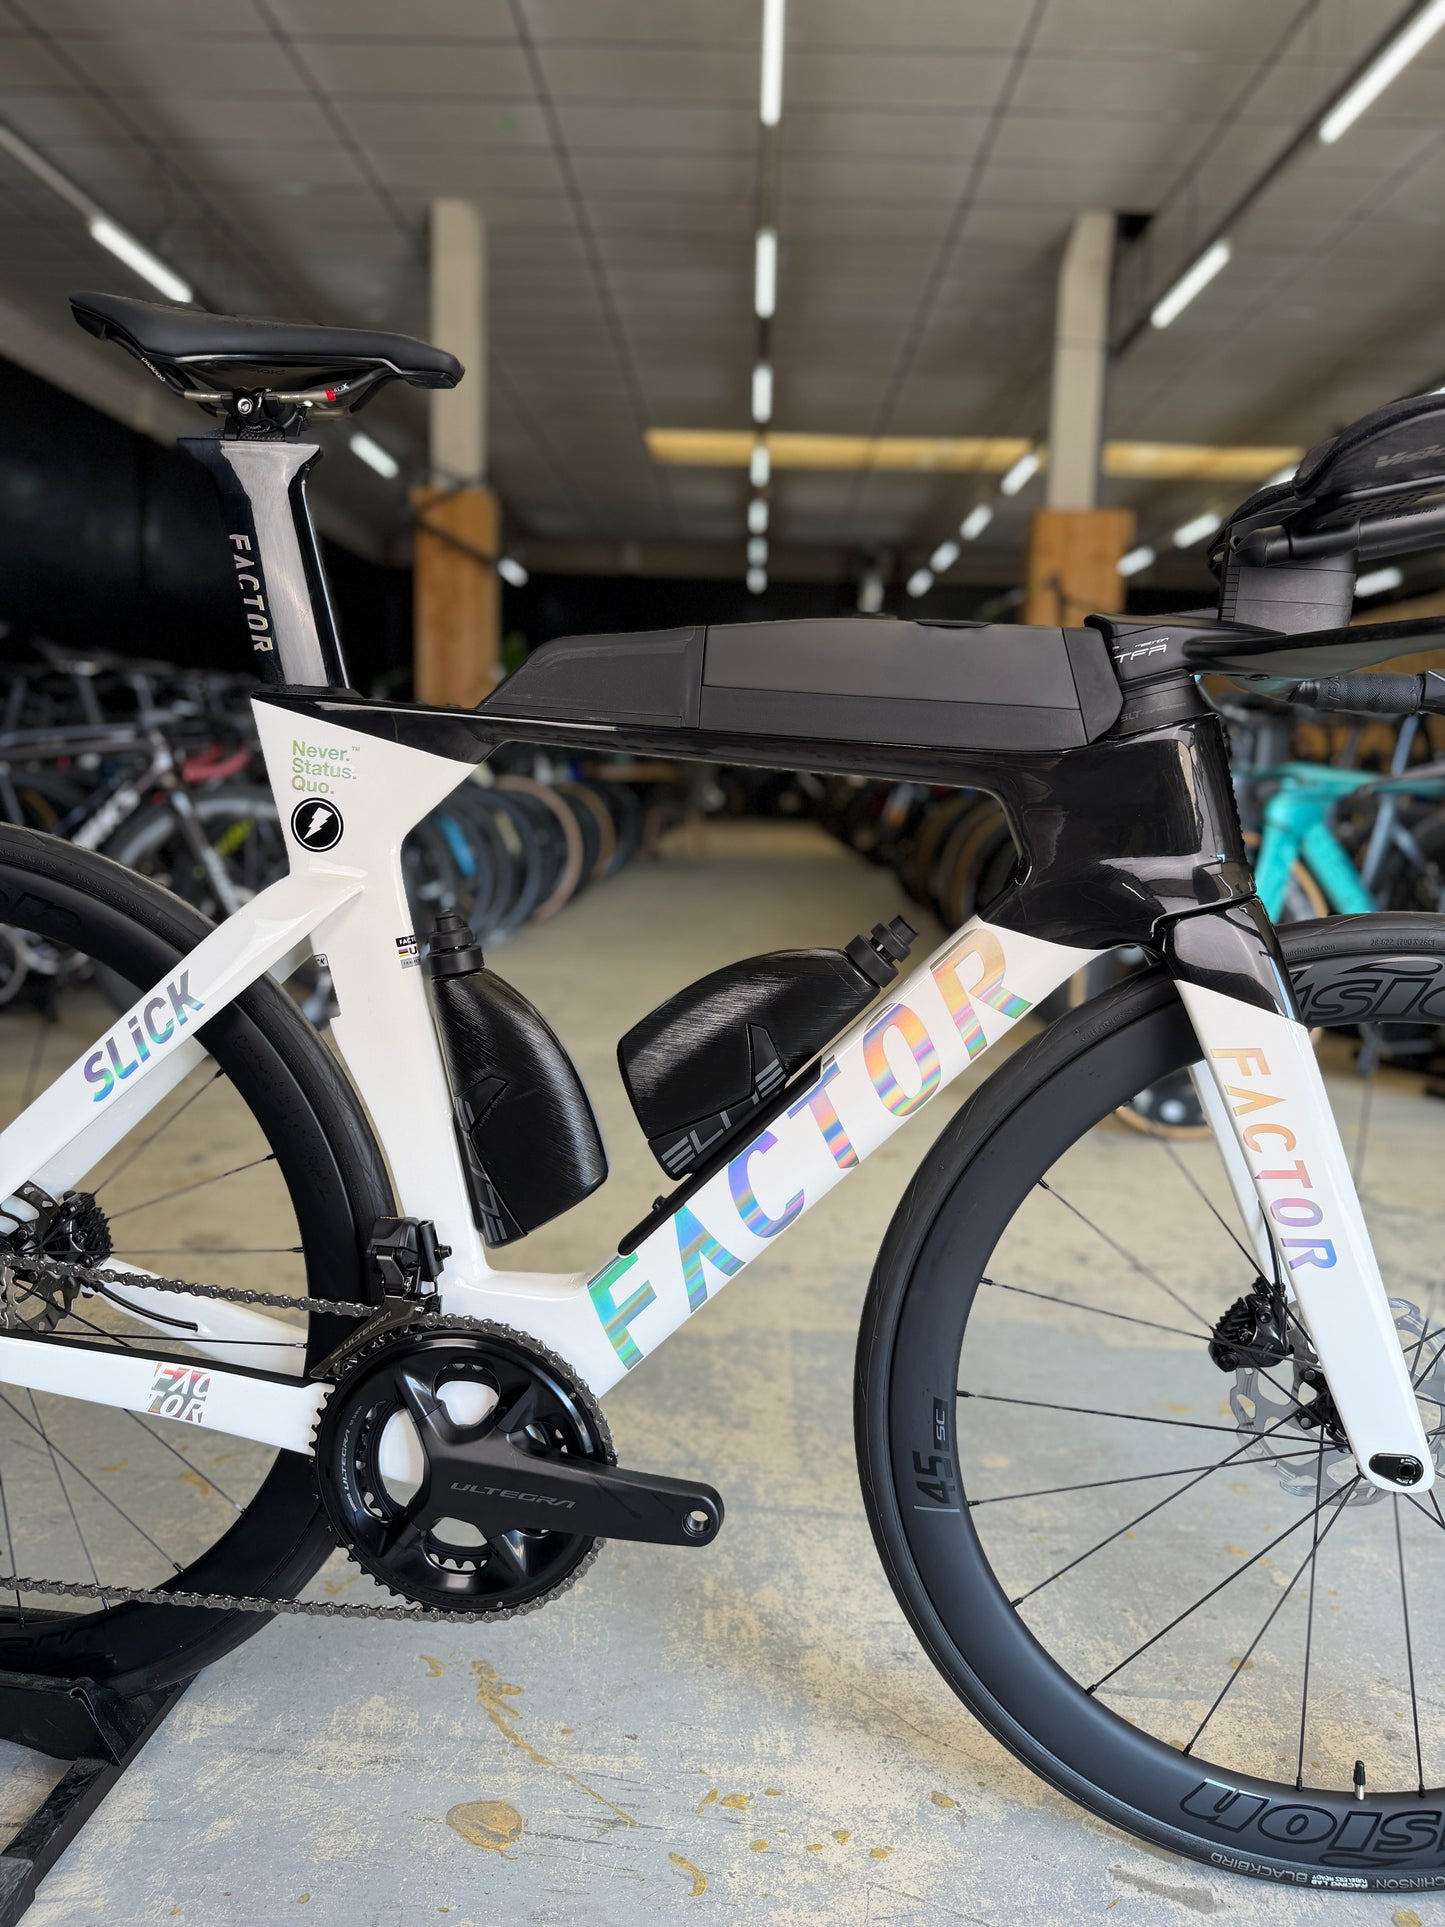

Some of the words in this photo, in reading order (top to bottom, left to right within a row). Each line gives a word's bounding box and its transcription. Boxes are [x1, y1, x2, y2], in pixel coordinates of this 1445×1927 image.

[229, 533, 274, 652] FACTOR
[1114, 643, 1167, 663] TFA
[291, 775, 334, 795] Quo.
[292, 757, 357, 779] Status.
[587, 928, 1034, 1371] FACTOR
[1210, 1048, 1337, 1270] FACTOR
[343, 1310, 392, 1350] ULTEGRA
[341, 1428, 351, 1491] ULTEGRA
[912, 1451, 955, 1504] 45
[936, 1408, 946, 1440] SC
[450, 1482, 577, 1509] ULTEGRA
[1210, 1851, 1308, 1883] BLACKBIRD
